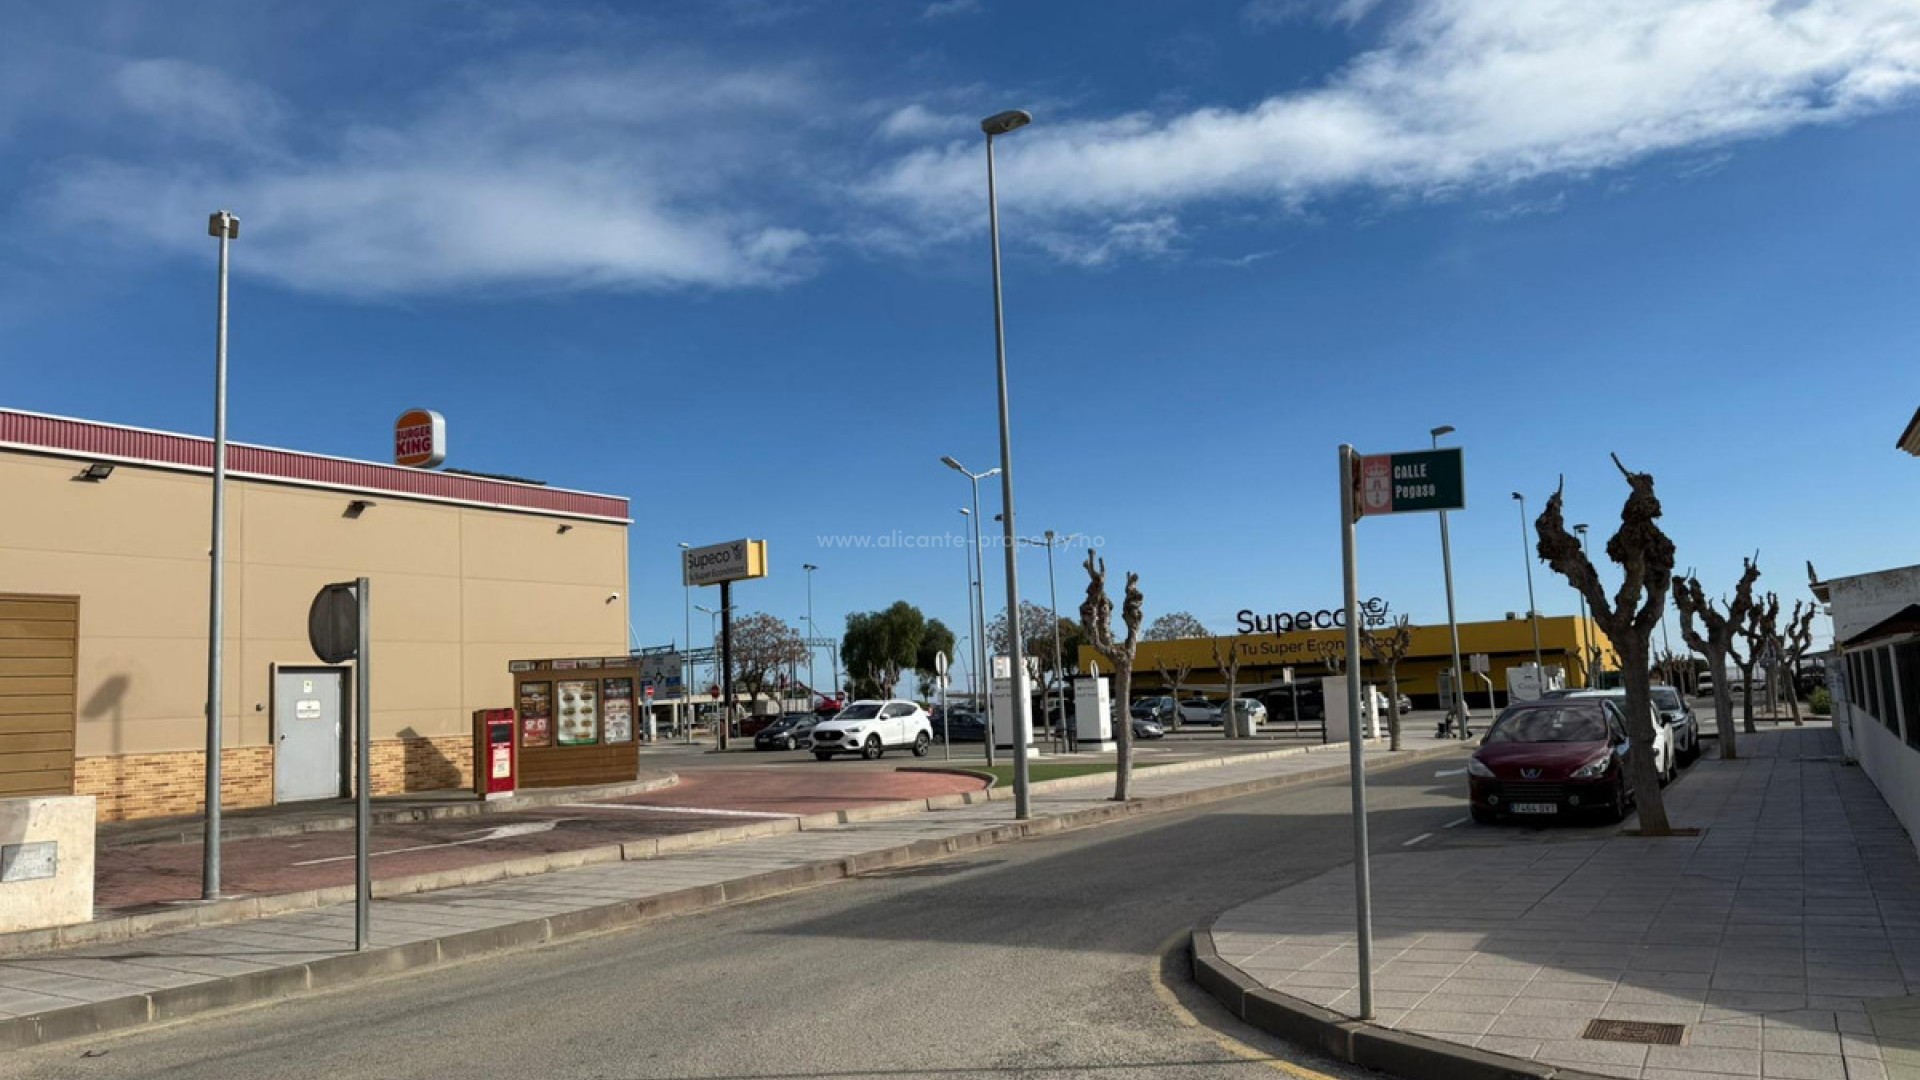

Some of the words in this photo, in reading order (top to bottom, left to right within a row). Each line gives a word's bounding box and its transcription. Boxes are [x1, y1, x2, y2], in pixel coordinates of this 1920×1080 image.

[397, 425, 431, 440] BURGER
[397, 437, 431, 455] KING
[1394, 464, 1427, 480] CALLE
[1396, 484, 1436, 499] Pegaso
[688, 551, 729, 569] Supeco
[1240, 642, 1258, 656] Tu
[1260, 641, 1303, 657] Super
